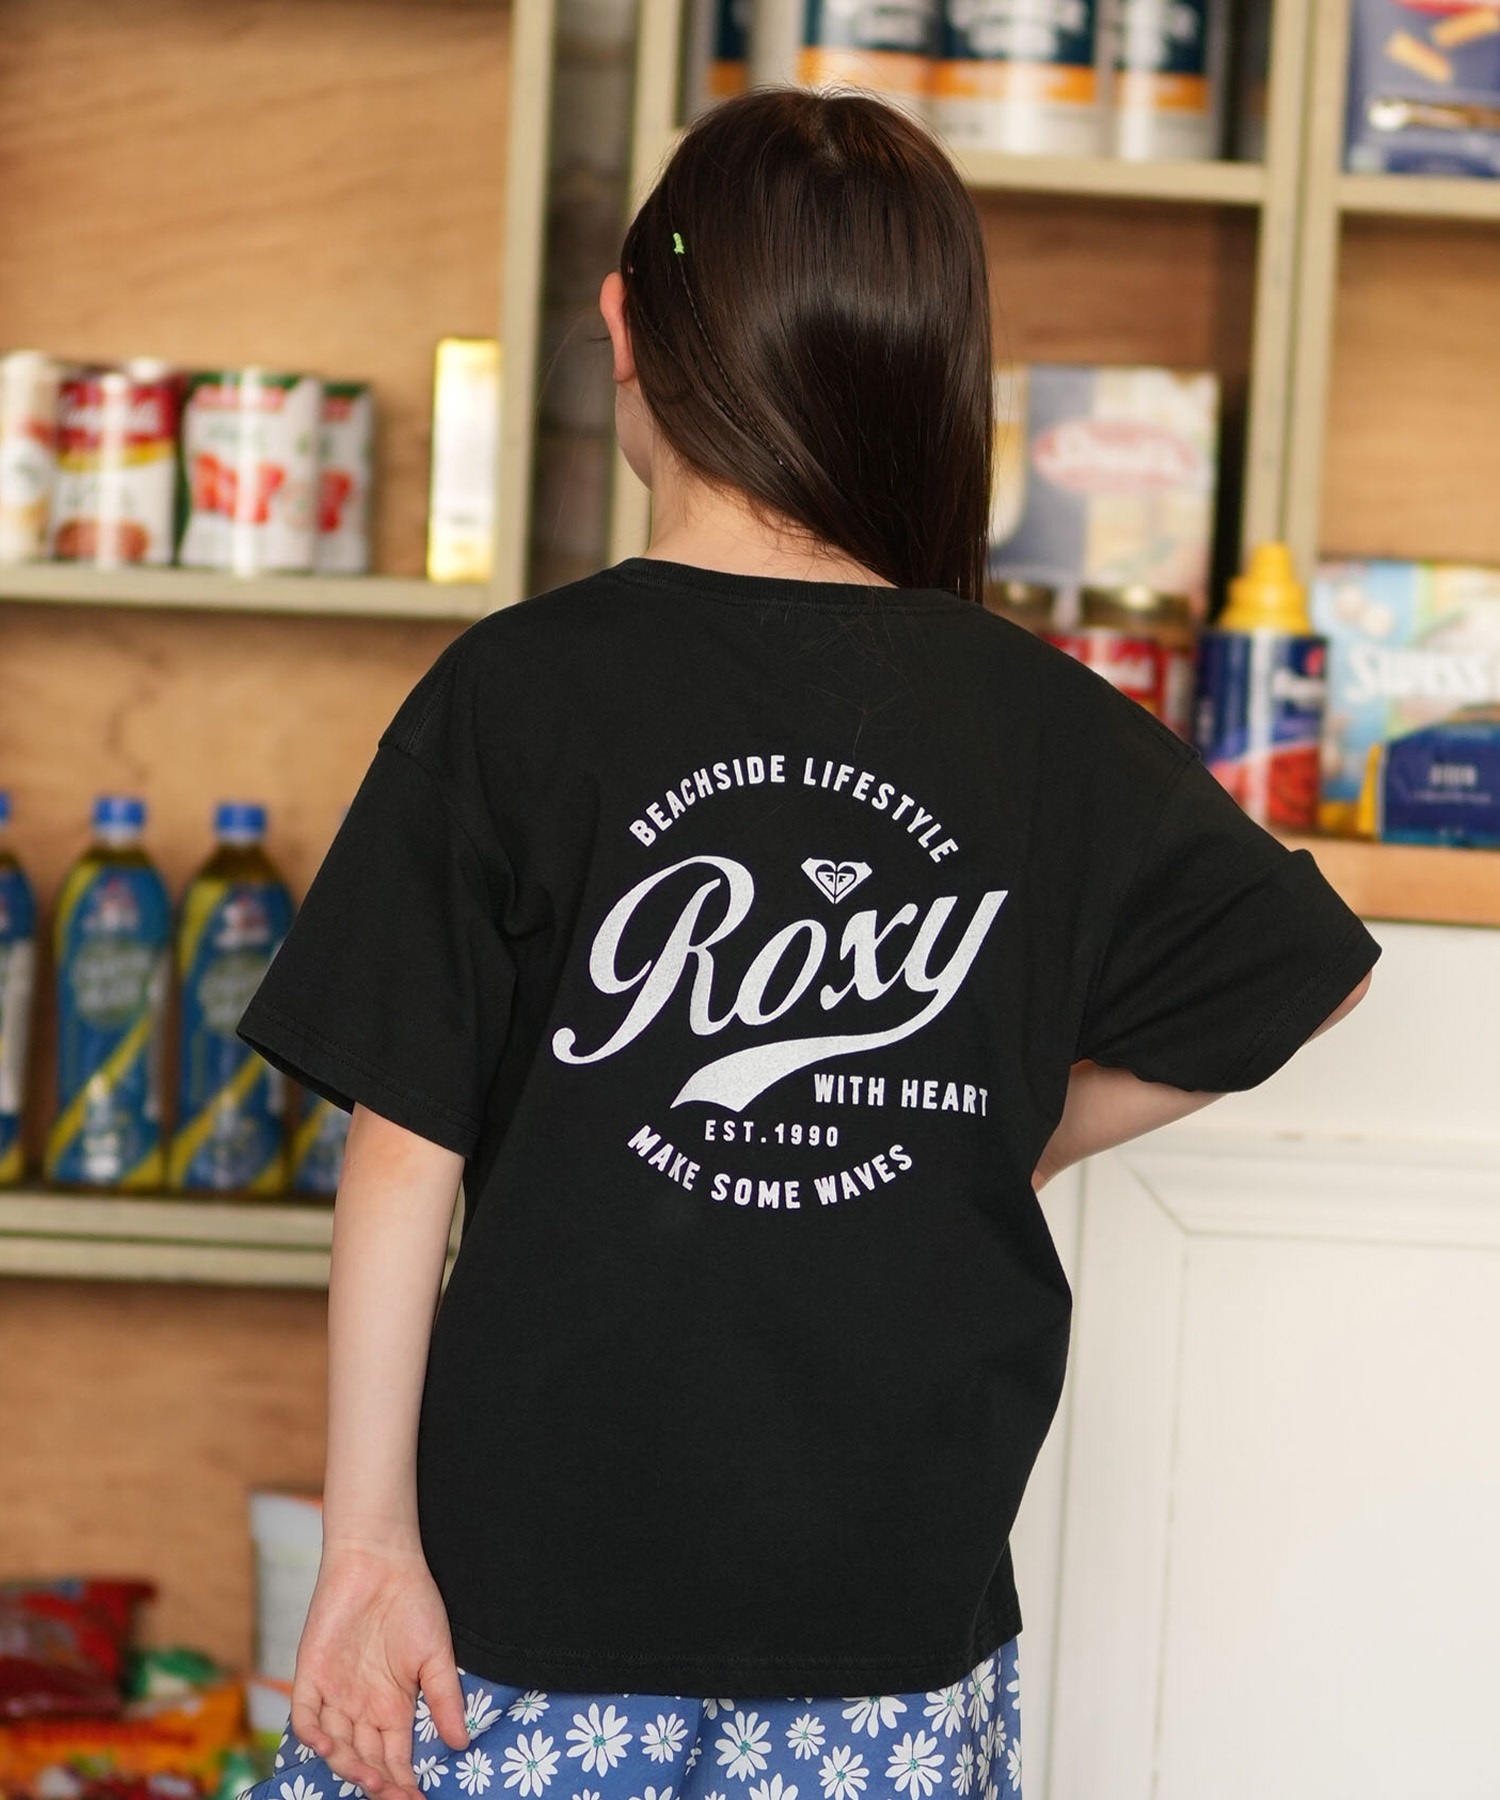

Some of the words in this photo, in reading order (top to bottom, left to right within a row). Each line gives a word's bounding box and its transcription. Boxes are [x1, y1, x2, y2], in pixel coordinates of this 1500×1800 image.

[628, 754, 786, 847] BEACHSIDE
[800, 757, 959, 864] LIFESTYLE
[551, 855, 1009, 1113] Roxy
[704, 1119, 839, 1148] EST.1990
[813, 1073, 886, 1107] WITH
[900, 1078, 988, 1117] HEART
[627, 1124, 701, 1191] MAKE
[710, 1173, 801, 1209] SOME
[814, 1143, 913, 1206] WAVES
